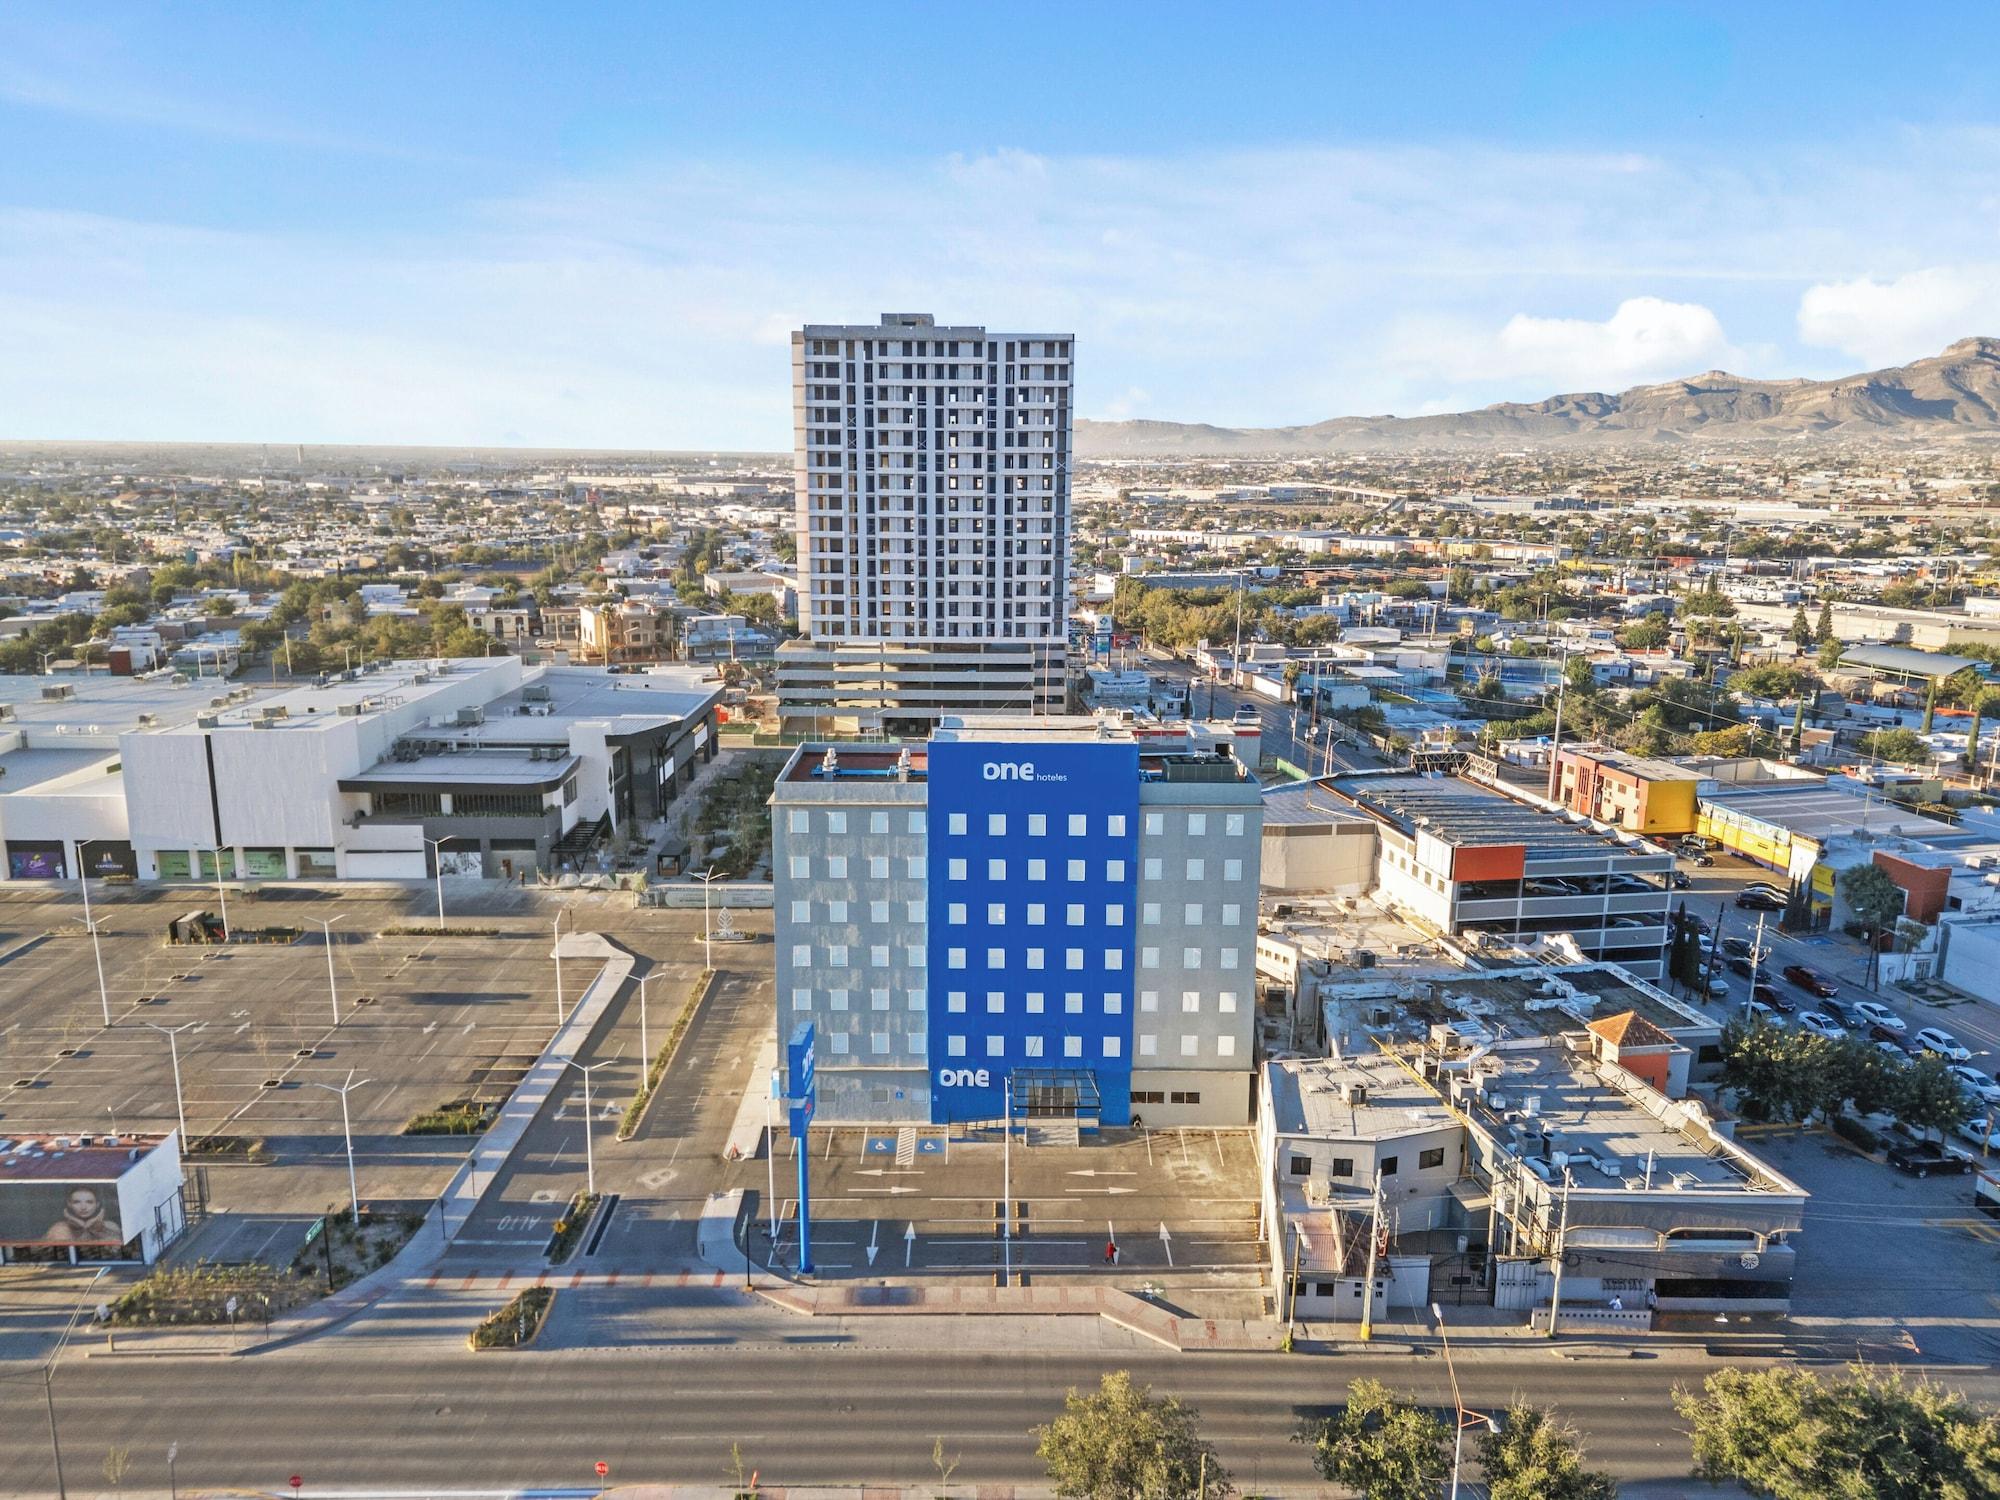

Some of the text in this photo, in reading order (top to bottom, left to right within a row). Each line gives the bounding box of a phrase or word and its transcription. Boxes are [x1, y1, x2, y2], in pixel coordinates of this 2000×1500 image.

[983, 762, 1068, 782] one hoteles
[939, 1069, 990, 1088] one
[496, 1215, 542, 1231] ALTO
